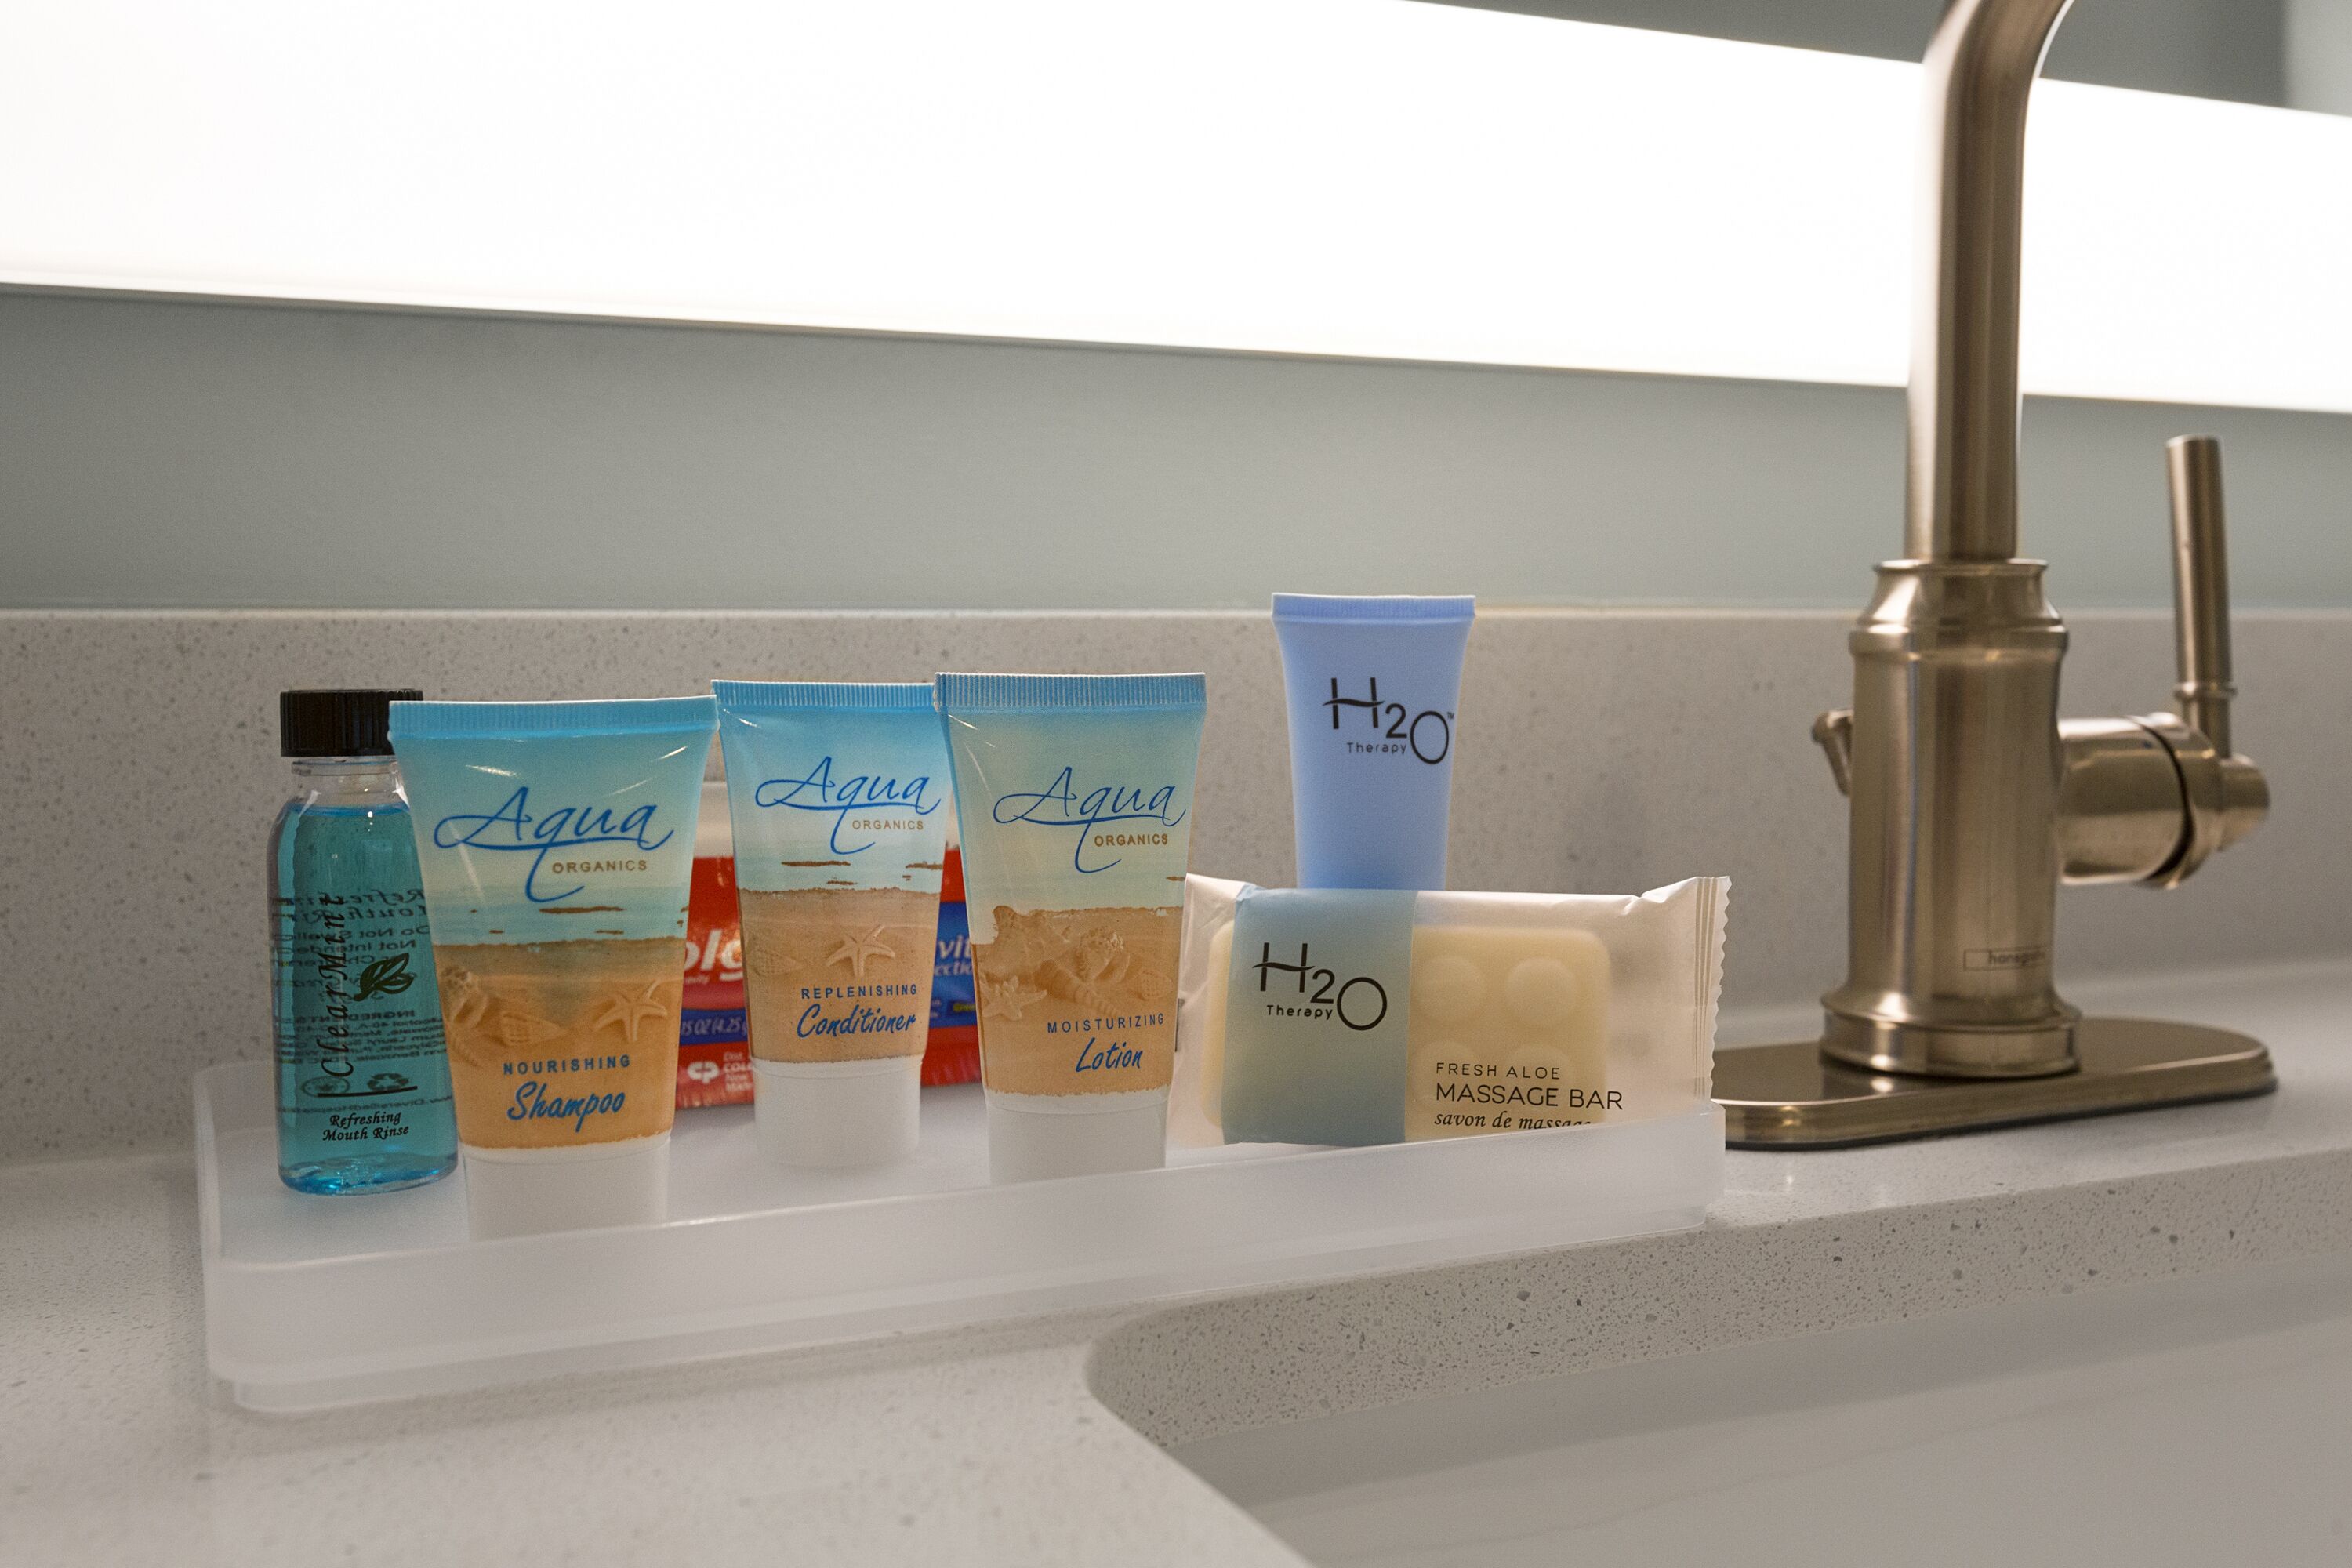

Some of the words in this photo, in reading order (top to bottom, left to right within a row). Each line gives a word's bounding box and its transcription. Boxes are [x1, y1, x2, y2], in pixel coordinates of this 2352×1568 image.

[1323, 677, 1449, 764] H2O
[1346, 742, 1408, 754] Therapy
[755, 756, 941, 855] Aqua
[851, 818, 924, 831] ORGANICS
[993, 766, 1187, 873] Aqua
[434, 786, 674, 902] Aqua
[1094, 833, 1169, 848] ORGANICS
[551, 859, 648, 875] ORGANICS
[800, 983, 917, 1000] REPLENISHING
[1252, 942, 1387, 1031] H2O
[797, 1003, 916, 1039] Conditioner
[1267, 1005, 1333, 1020] Therapy
[1047, 1013, 1165, 1034] MOISTURIZING
[503, 1054, 631, 1076] NOURISHING
[1076, 1036, 1145, 1073] Lotion
[1436, 1062, 1497, 1077] FRESH
[1506, 1065, 1560, 1080] ALOE
[507, 1080, 626, 1132] Shampoo
[1436, 1083, 1559, 1107] MASSAGE
[1570, 1089, 1623, 1110] BAR
[329, 1110, 402, 1130] Refreshing
[1434, 1112, 1486, 1127] savon
[1492, 1110, 1512, 1128] de
[322, 1127, 368, 1142] Mouth
[372, 1126, 410, 1141] Rinse
